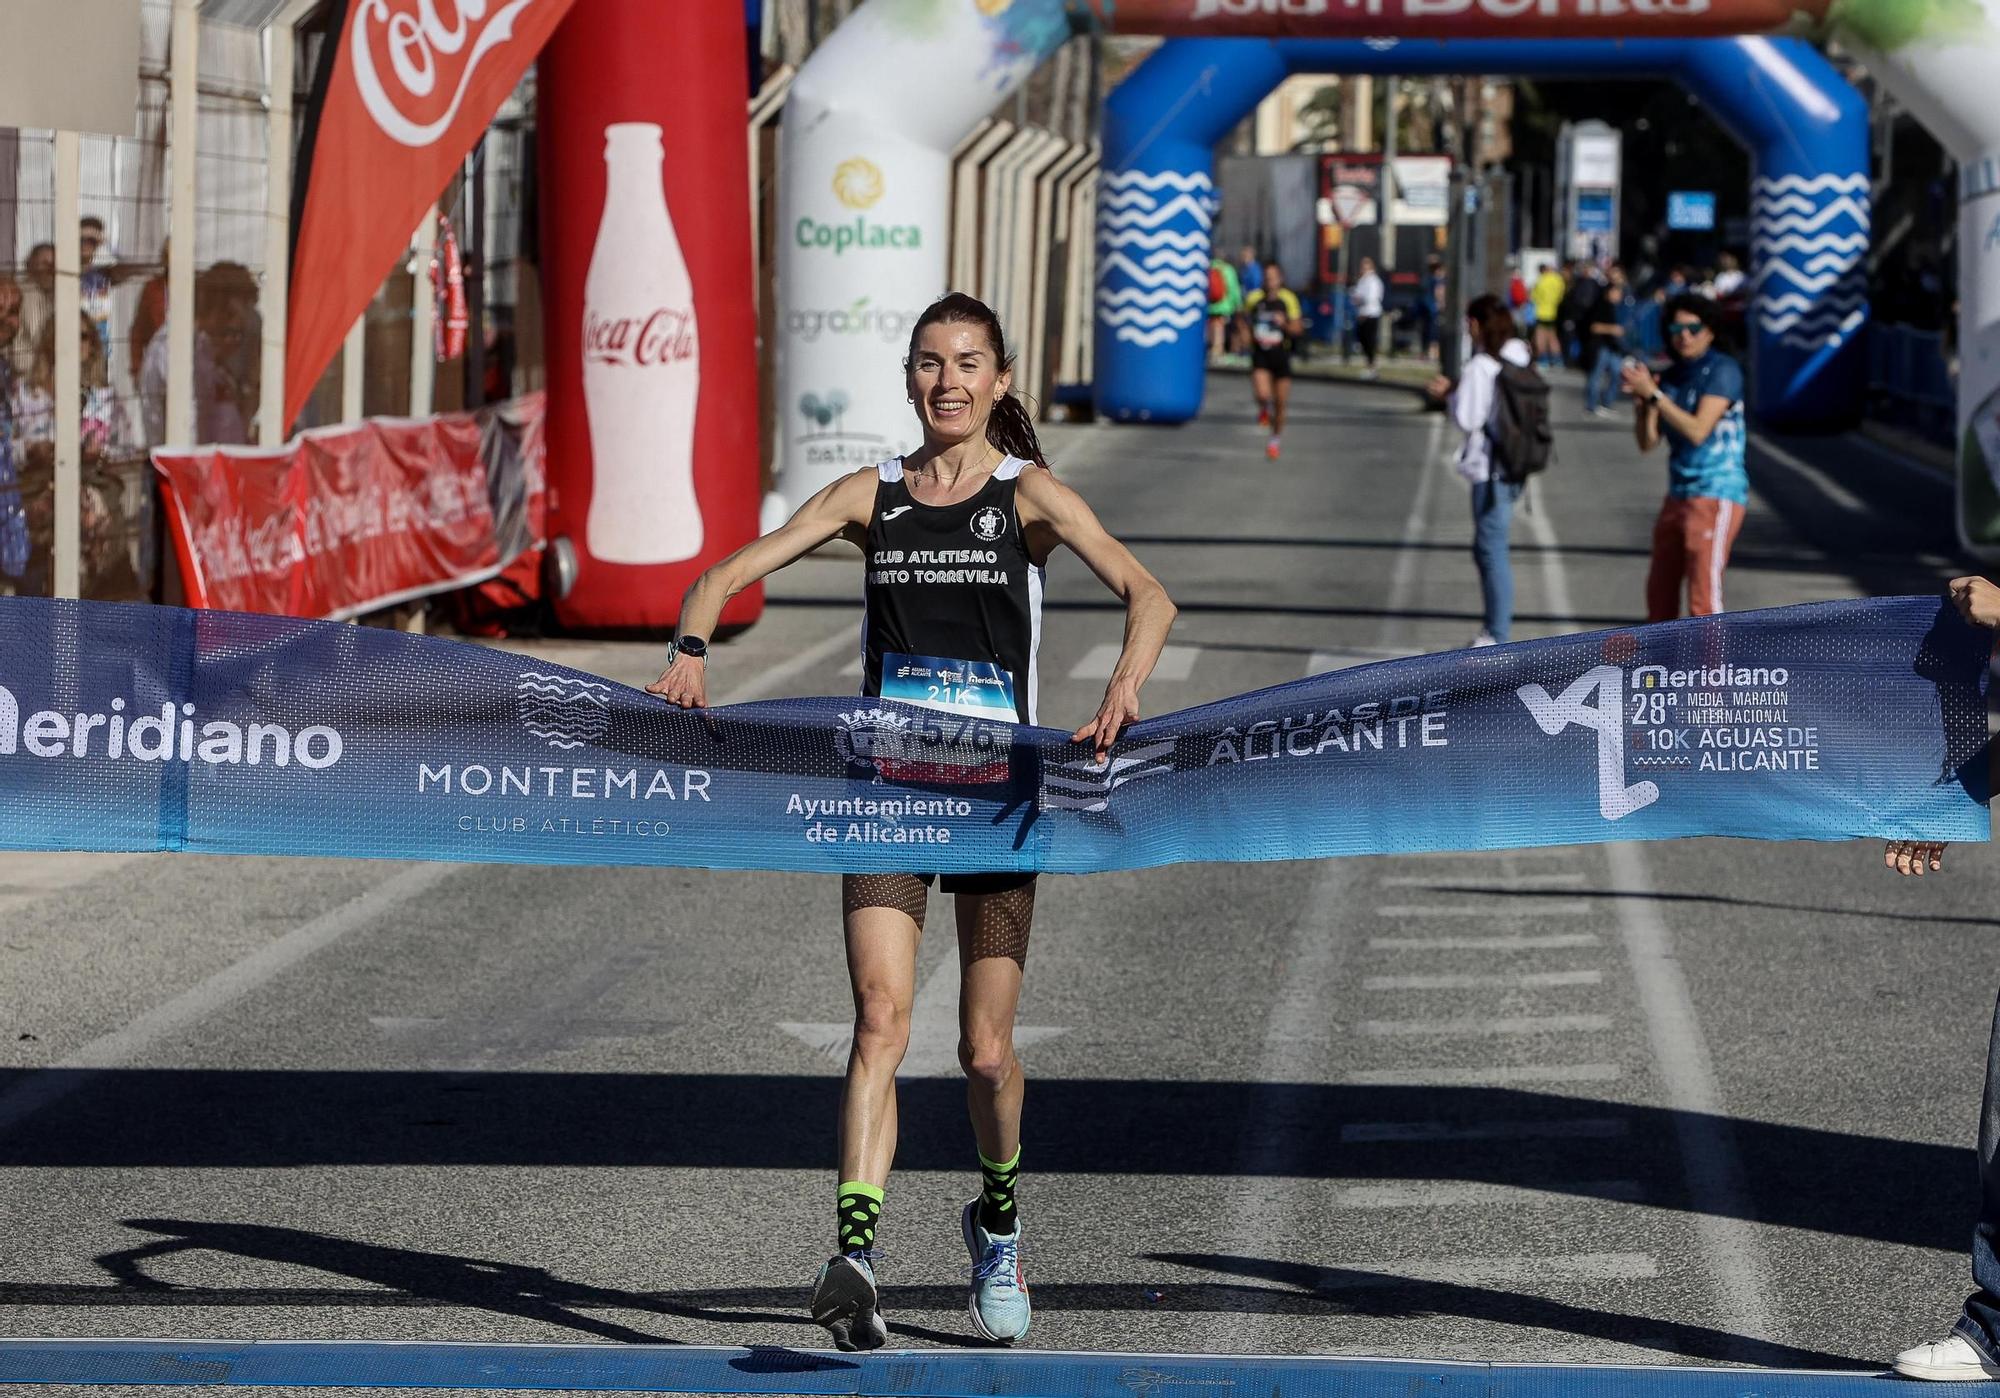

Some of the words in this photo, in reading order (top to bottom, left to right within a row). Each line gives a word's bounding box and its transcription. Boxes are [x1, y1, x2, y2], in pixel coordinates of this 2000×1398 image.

[795, 216, 922, 255] Coplaca
[874, 551, 904, 565] CLUB
[908, 550, 998, 565] ATLETISMO
[914, 569, 1009, 586] TORREVIEJA
[927, 685, 969, 705] 21K
[1687, 692, 1724, 706] MEDIA
[1732, 690, 1789, 706] MARATÓN
[1687, 709, 1789, 724] INTERNACIONAL
[1206, 711, 1449, 766] ALICANTE
[1646, 728, 1691, 750] 10K
[1698, 727, 1784, 749] AGUAS
[1787, 727, 1819, 748] DE
[1698, 750, 1820, 771] ALICANTE
[418, 763, 712, 802] MONTEMAR
[785, 793, 972, 820] Ayuntamiento
[457, 815, 526, 833] CLUB
[540, 816, 671, 837] ATLÉTICO
[805, 821, 838, 843] de
[844, 822, 951, 843] Alicante
